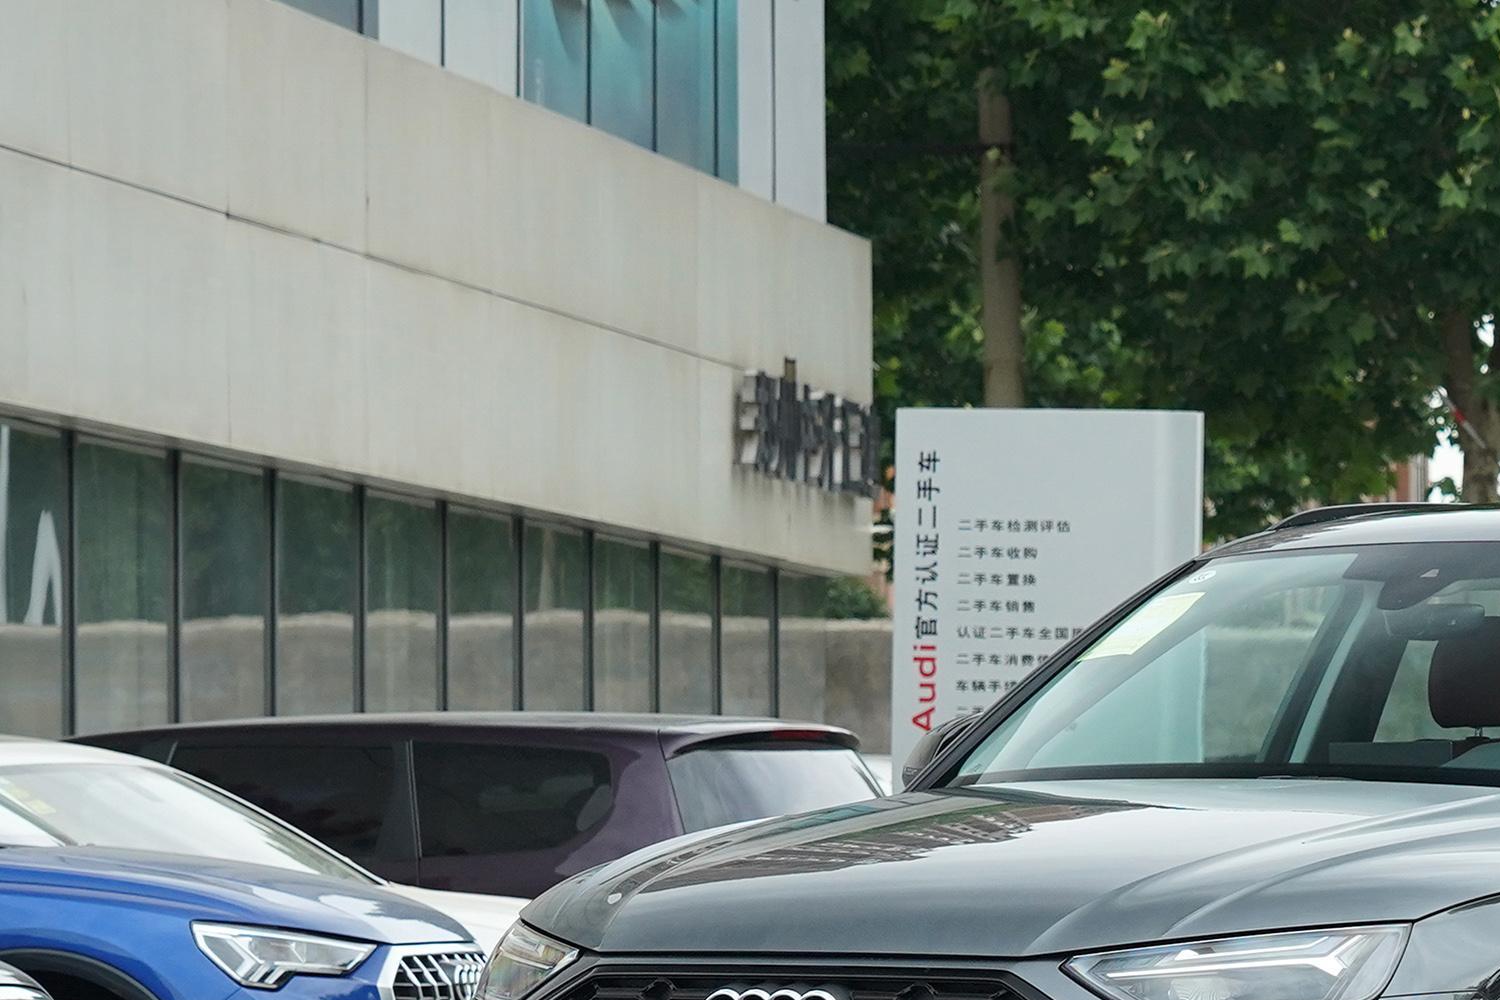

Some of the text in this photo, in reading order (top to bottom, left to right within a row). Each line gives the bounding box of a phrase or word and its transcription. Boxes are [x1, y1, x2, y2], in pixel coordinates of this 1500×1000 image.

[957, 520, 1071, 533] 二手车检测评估
[957, 547, 1038, 560] 二手车收购
[957, 573, 1037, 587] 二手车置换
[957, 600, 1036, 613] 二手车销售
